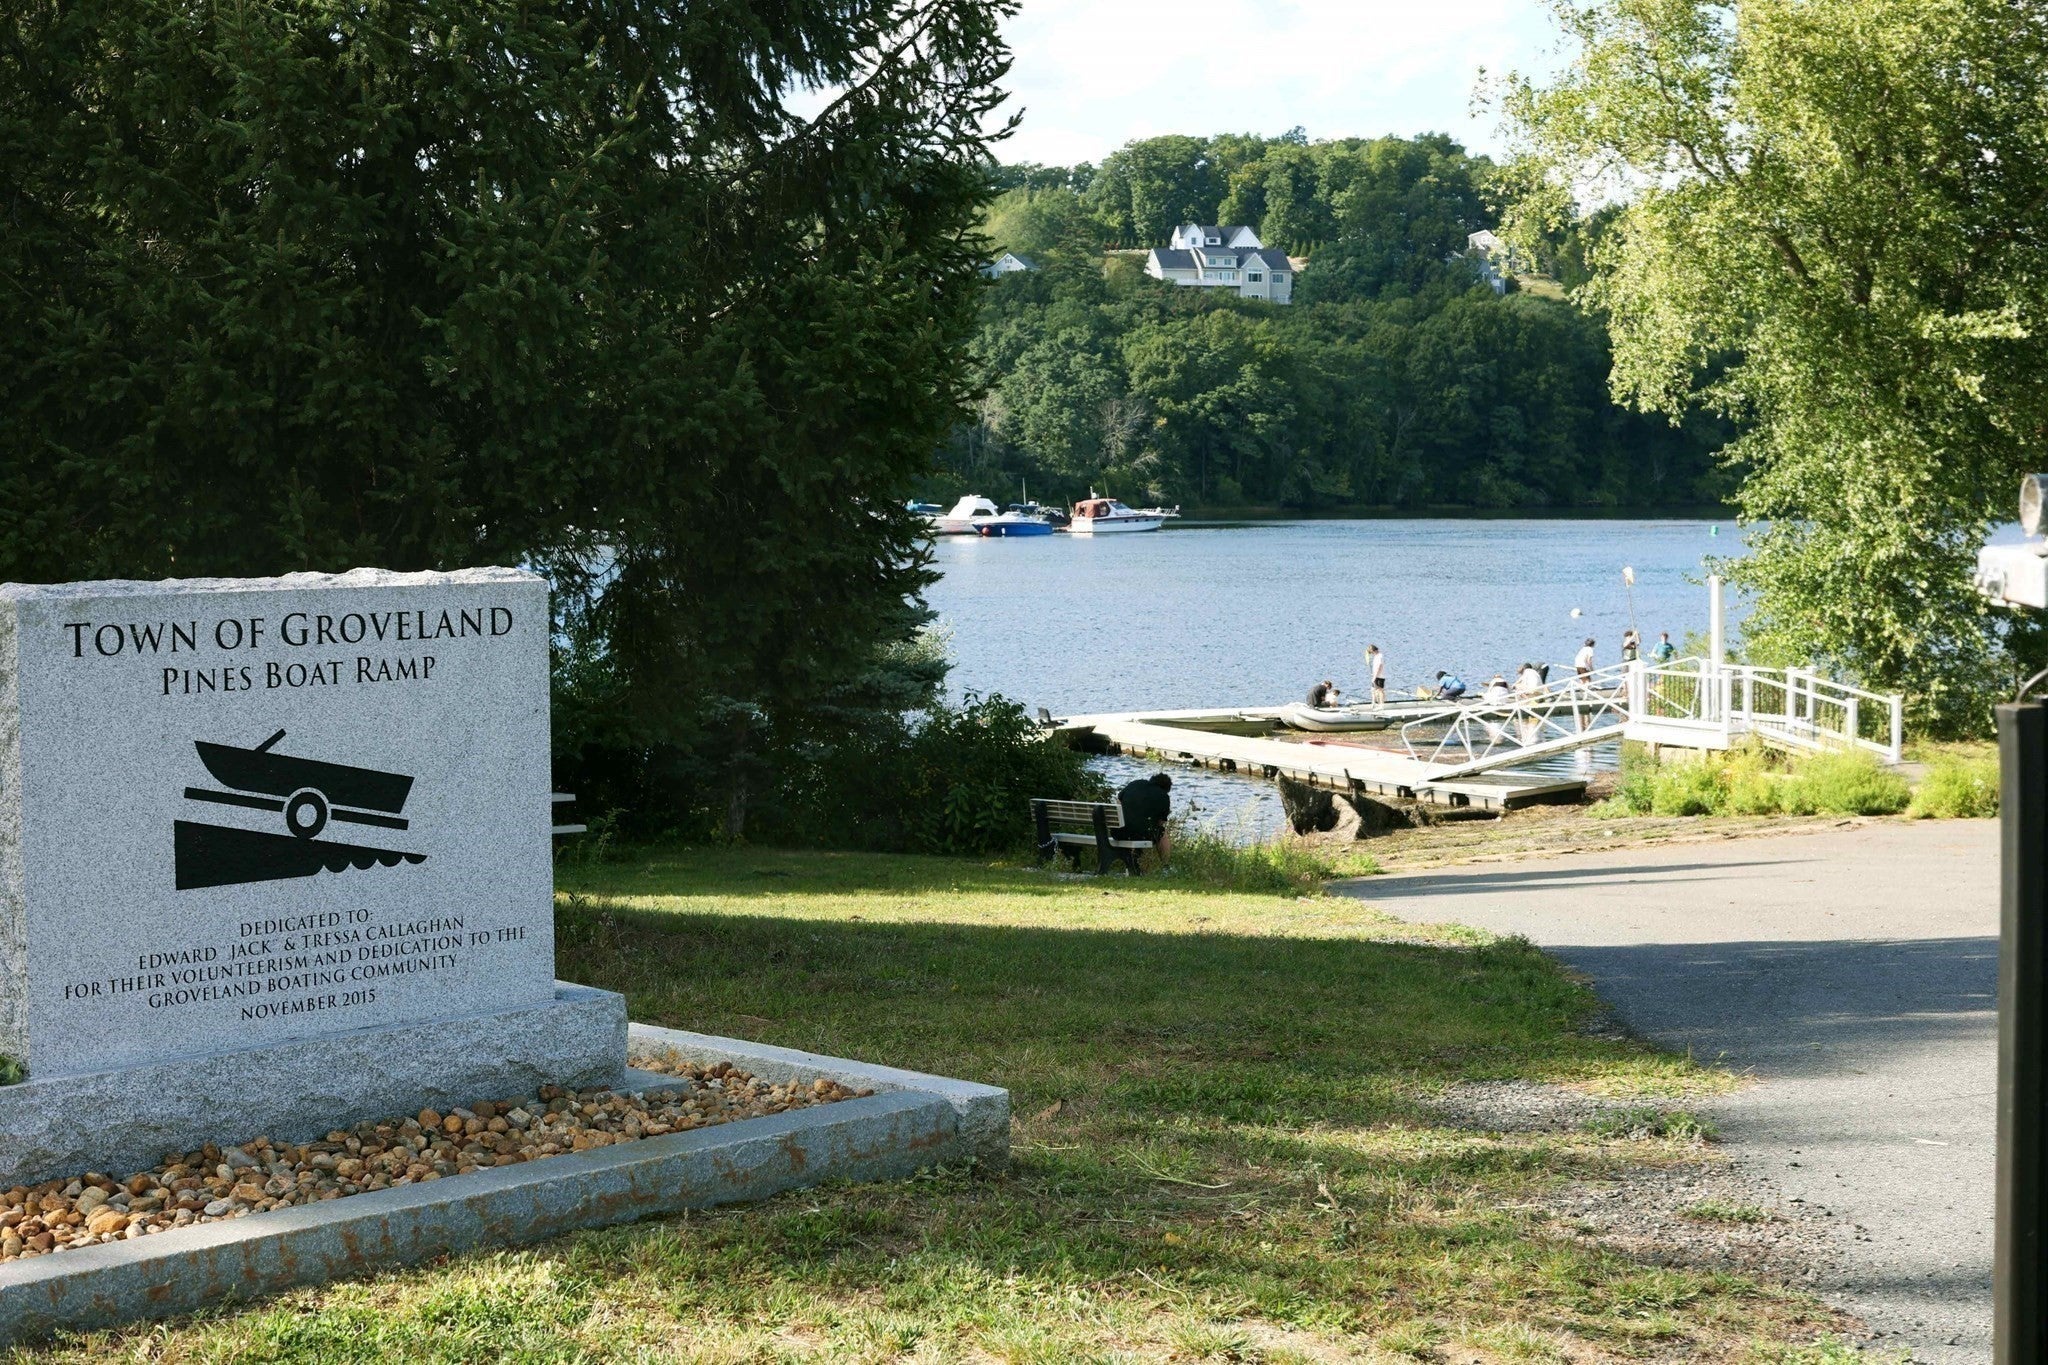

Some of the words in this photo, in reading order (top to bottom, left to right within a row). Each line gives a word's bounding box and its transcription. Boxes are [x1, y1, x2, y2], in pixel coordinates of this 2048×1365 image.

[64, 621, 197, 658] TOWN
[215, 618, 265, 650] OF
[280, 607, 513, 647] GROVELAND
[162, 666, 251, 696] PINES
[266, 661, 343, 689] BOAT
[356, 656, 436, 683] RAMP
[139, 946, 217, 970] EDWARD
[284, 936, 296, 951] &
[301, 929, 361, 950] TRESSA
[366, 915, 465, 941] CALLAGHAN
[240, 912, 340, 937] DEDICATED
[347, 908, 373, 924] TO:
[65, 981, 101, 1000] FOR
[108, 973, 166, 994] THEIR
[171, 955, 308, 985] VOLUNTEERISM
[314, 949, 352, 967] AND
[358, 934, 463, 961] DEDICATION
[469, 931, 491, 946] TO
[498, 926, 527, 942] THE
[149, 980, 262, 1009] GROVELAND
[268, 969, 346, 993] BOATING
[351, 954, 458, 981] COMMUNITY
[241, 994, 338, 1021] NOVEMBER
[342, 988, 376, 1007] 2015
